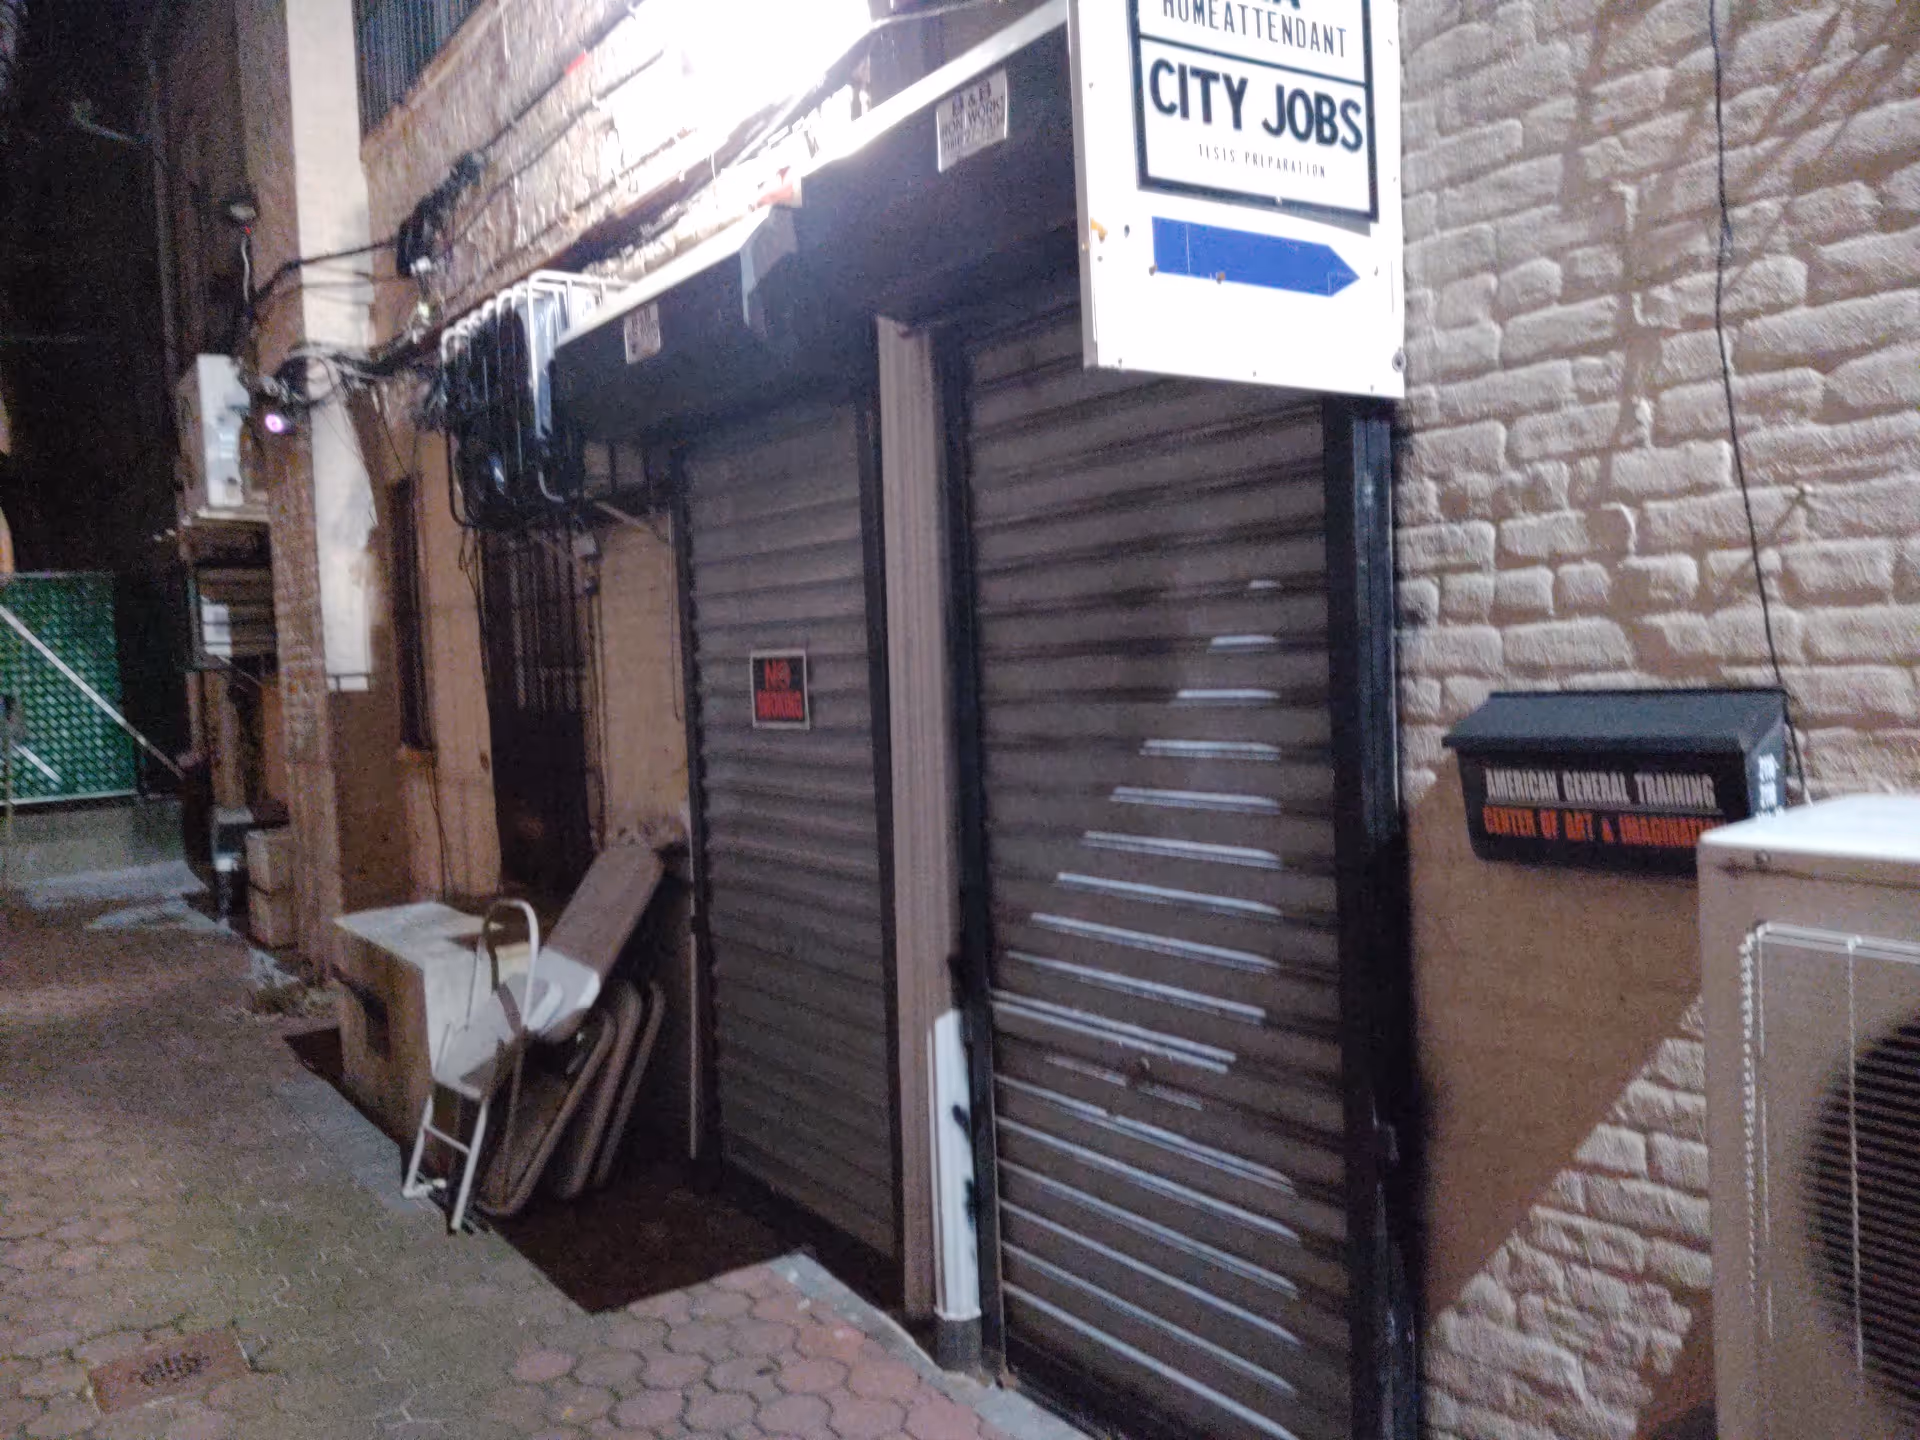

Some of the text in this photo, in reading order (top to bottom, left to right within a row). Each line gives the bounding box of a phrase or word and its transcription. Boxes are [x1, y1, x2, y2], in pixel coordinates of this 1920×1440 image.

[1149, 58, 1363, 154] CITY JOBS
[1485, 768, 1717, 808] AMERICAN GENERAL TRAINING
[1482, 805, 1536, 837] CENTER
[1539, 808, 1557, 839] OF
